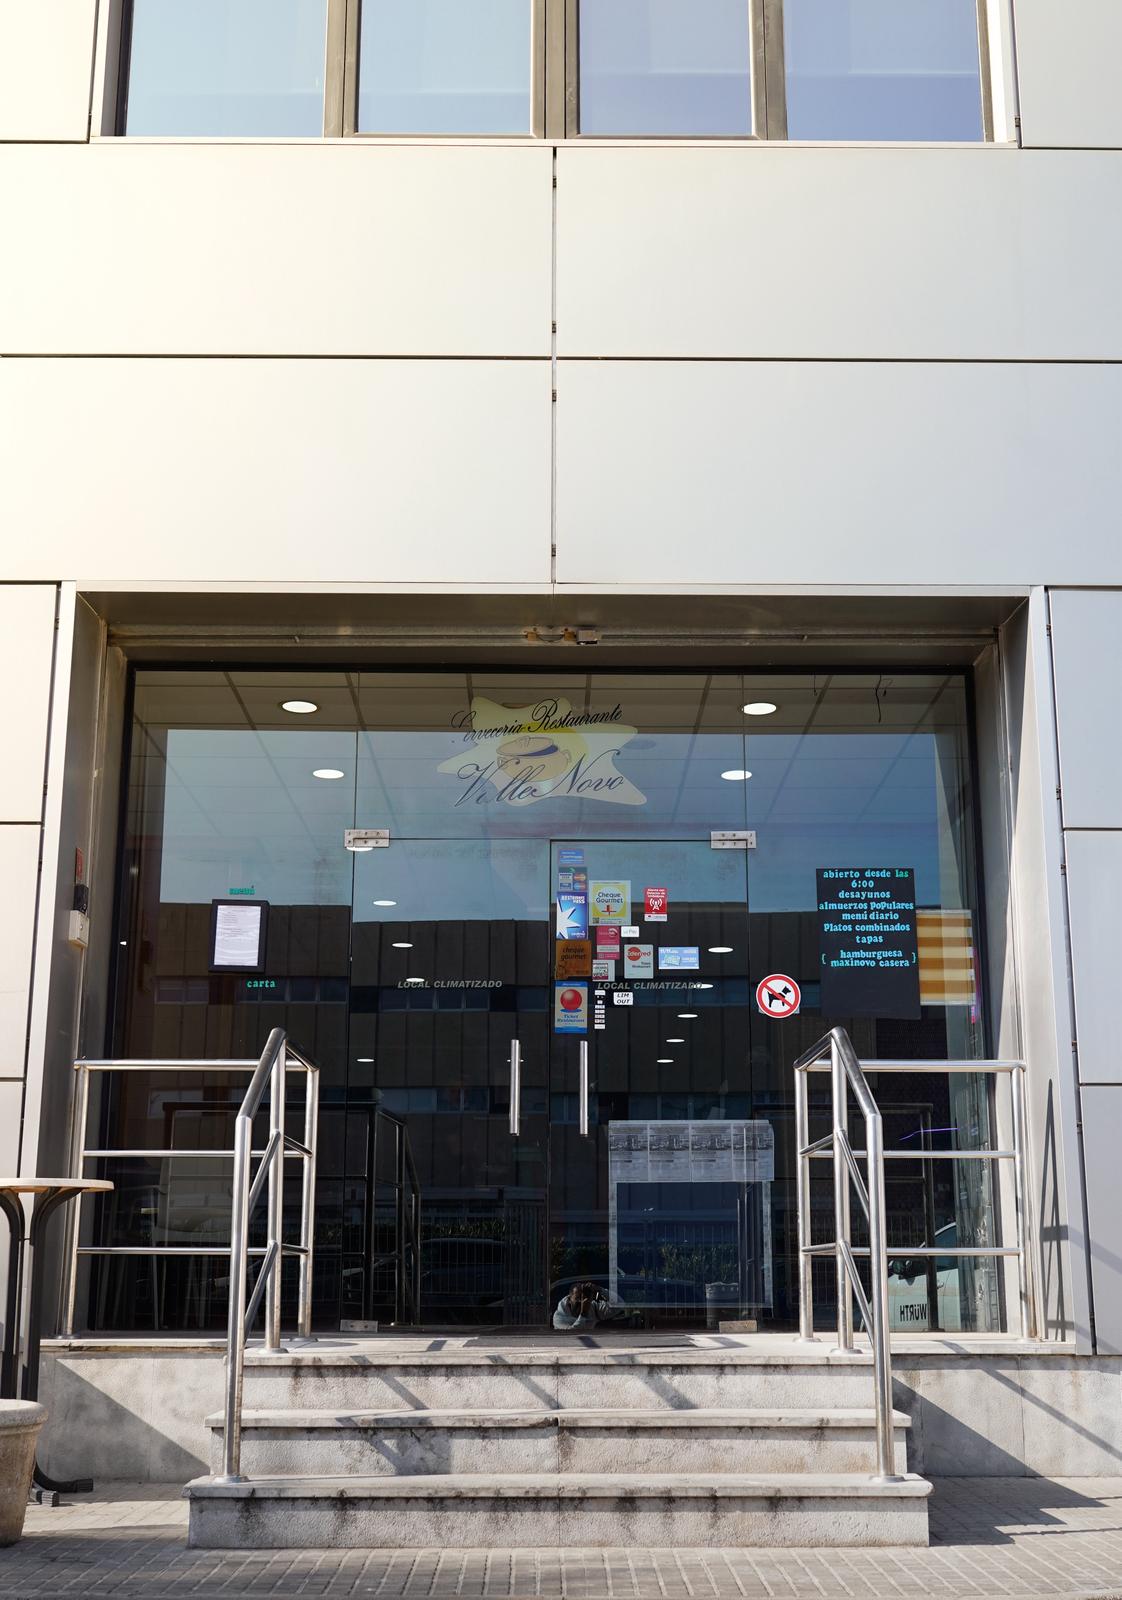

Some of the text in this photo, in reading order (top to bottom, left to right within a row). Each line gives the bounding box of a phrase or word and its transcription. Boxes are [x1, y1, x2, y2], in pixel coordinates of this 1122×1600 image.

[528, 698, 622, 731] Restaurante
[551, 749, 623, 795] Novo
[823, 869, 909, 878] abierto desde las
[851, 879, 874, 888] 6:00
[838, 890, 891, 899] desayunos
[819, 902, 868, 910] almuerzos
[842, 910, 899, 920] menú diario
[855, 923, 910, 932] combinados
[856, 935, 883, 944] tapas
[840, 950, 903, 960] hamburguesa
[830, 958, 910, 967] maxinovo casera
[246, 980, 276, 988] carta
[398, 979, 503, 989] LOCAL CLIMATIZADO
[598, 982, 702, 990] LOCAL CLIMATIZADO
